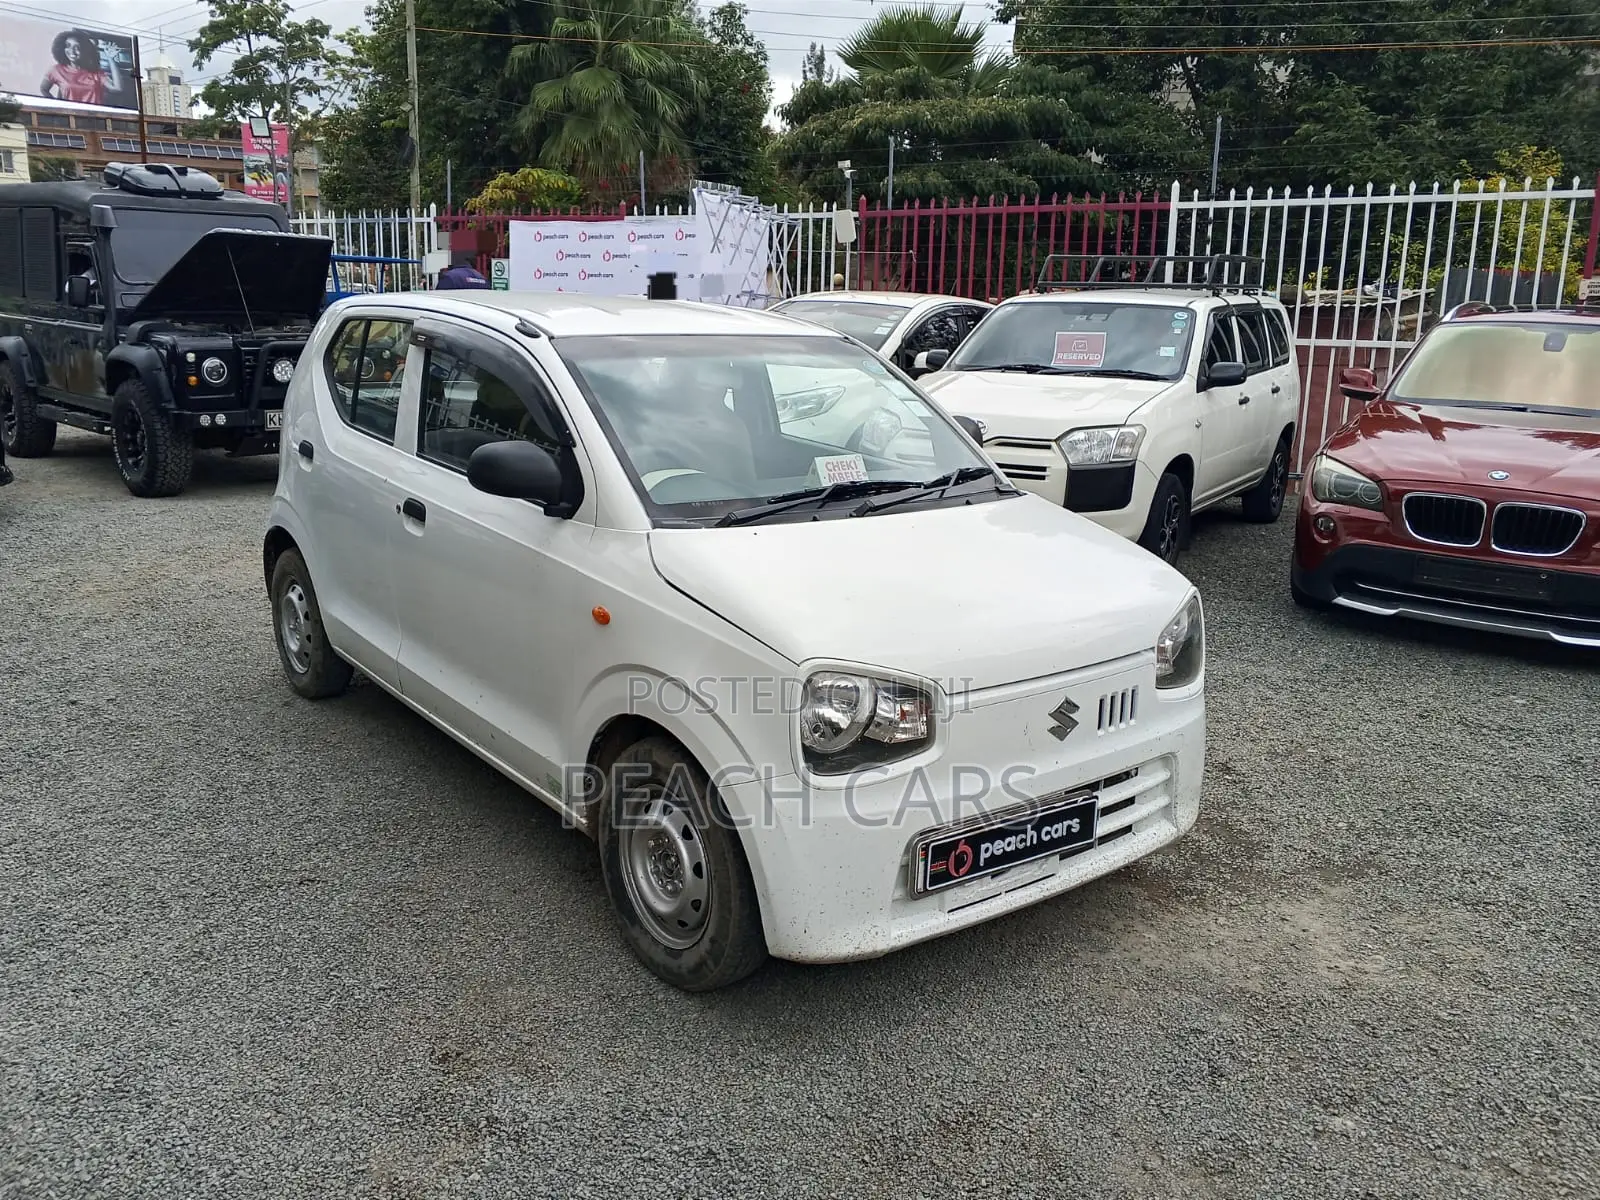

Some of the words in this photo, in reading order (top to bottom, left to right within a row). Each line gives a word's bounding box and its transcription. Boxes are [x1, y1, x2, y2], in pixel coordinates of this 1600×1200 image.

[543, 233, 557, 241] peach
[588, 233, 603, 241] peach
[637, 233, 653, 241] peach
[564, 251, 579, 260] peach
[587, 271, 602, 279] peach
[1057, 352, 1101, 361] RESERVED
[825, 460, 858, 472] CHEKI
[828, 471, 863, 483] MBELE
[979, 825, 1037, 867] peach
[1041, 817, 1081, 842] cars
